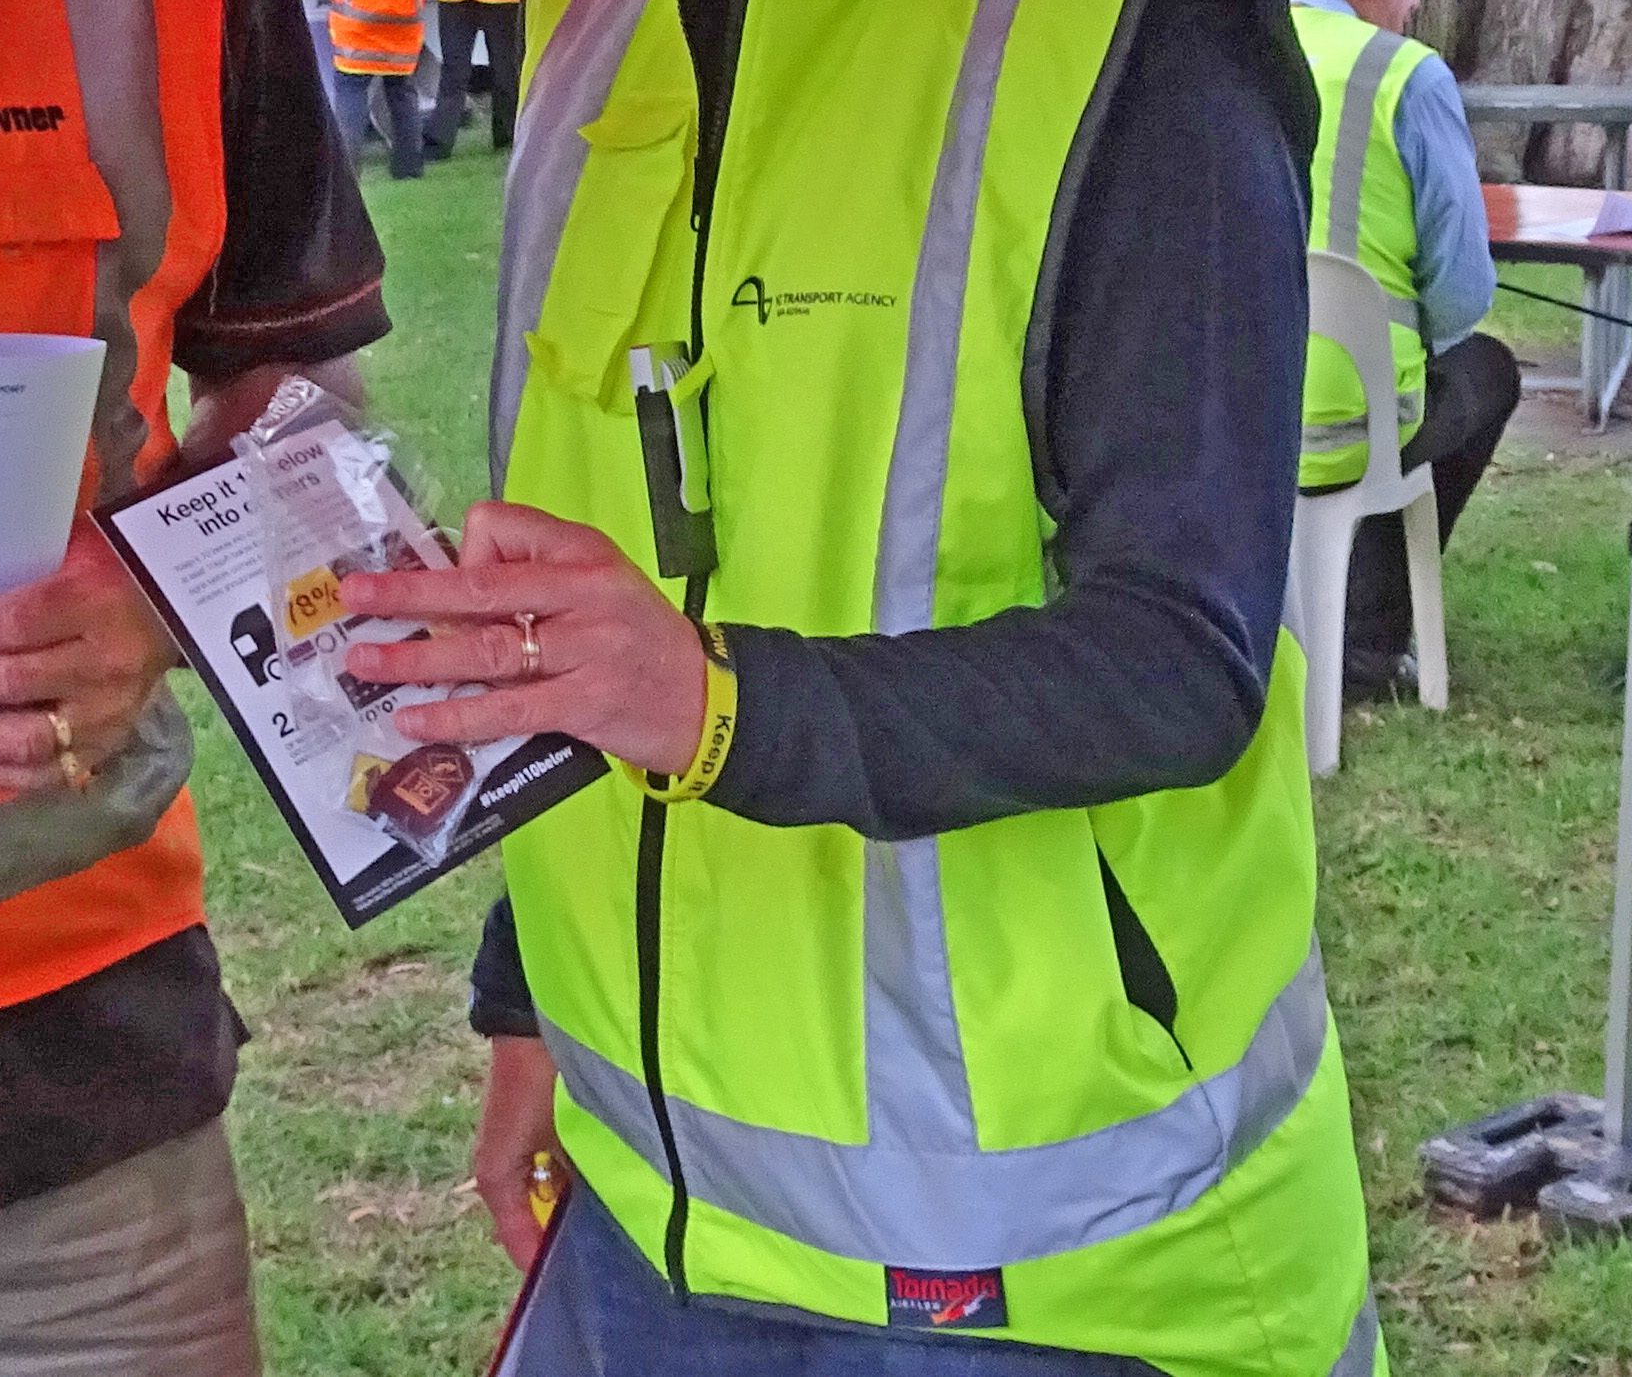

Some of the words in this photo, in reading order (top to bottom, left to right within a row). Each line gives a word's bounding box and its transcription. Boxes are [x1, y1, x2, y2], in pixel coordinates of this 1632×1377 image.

[783, 292, 844, 305] TRANSPORT
[845, 293, 898, 308] AGENCY
[156, 490, 218, 527] Keep
[214, 479, 237, 499] it
[277, 442, 324, 473] elow
[194, 508, 241, 537] into
[702, 714, 732, 774] Keep
[479, 745, 575, 809] #keepit10below
[890, 1269, 998, 1301] Tornado
